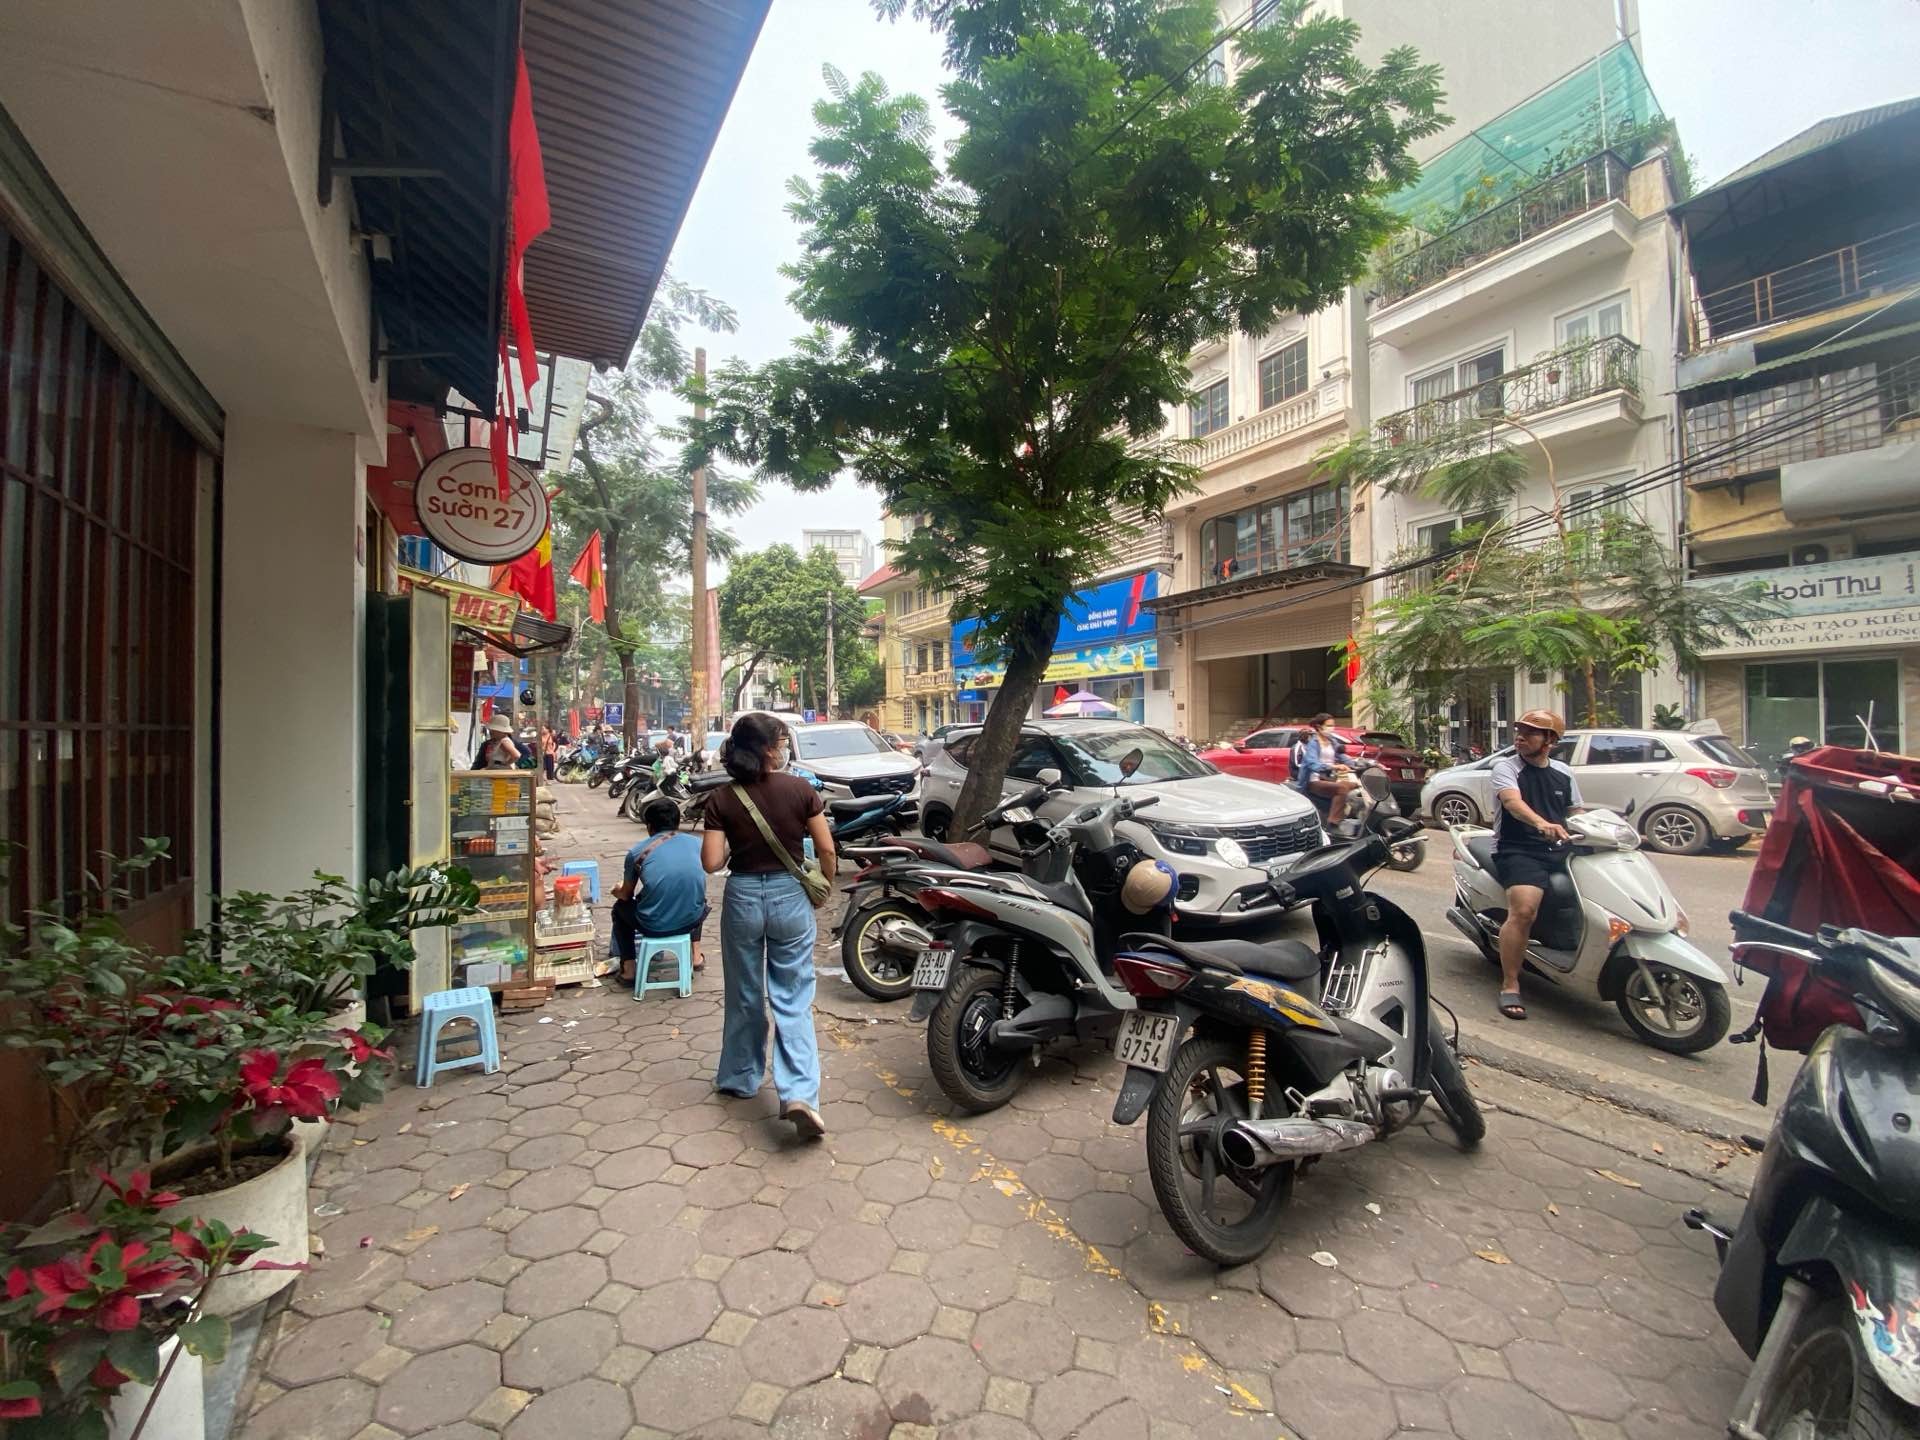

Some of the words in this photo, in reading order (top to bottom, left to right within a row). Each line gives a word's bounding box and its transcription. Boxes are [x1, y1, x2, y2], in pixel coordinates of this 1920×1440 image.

[437, 475, 497, 500] Cơm
[428, 496, 488, 521] Sườn
[493, 507, 525, 530] 27
[1824, 575, 1881, 595] Thu
[1812, 618, 1858, 633] TẠO
[914, 970, 945, 987] 123.27
[1121, 1036, 1162, 1067] 9754
